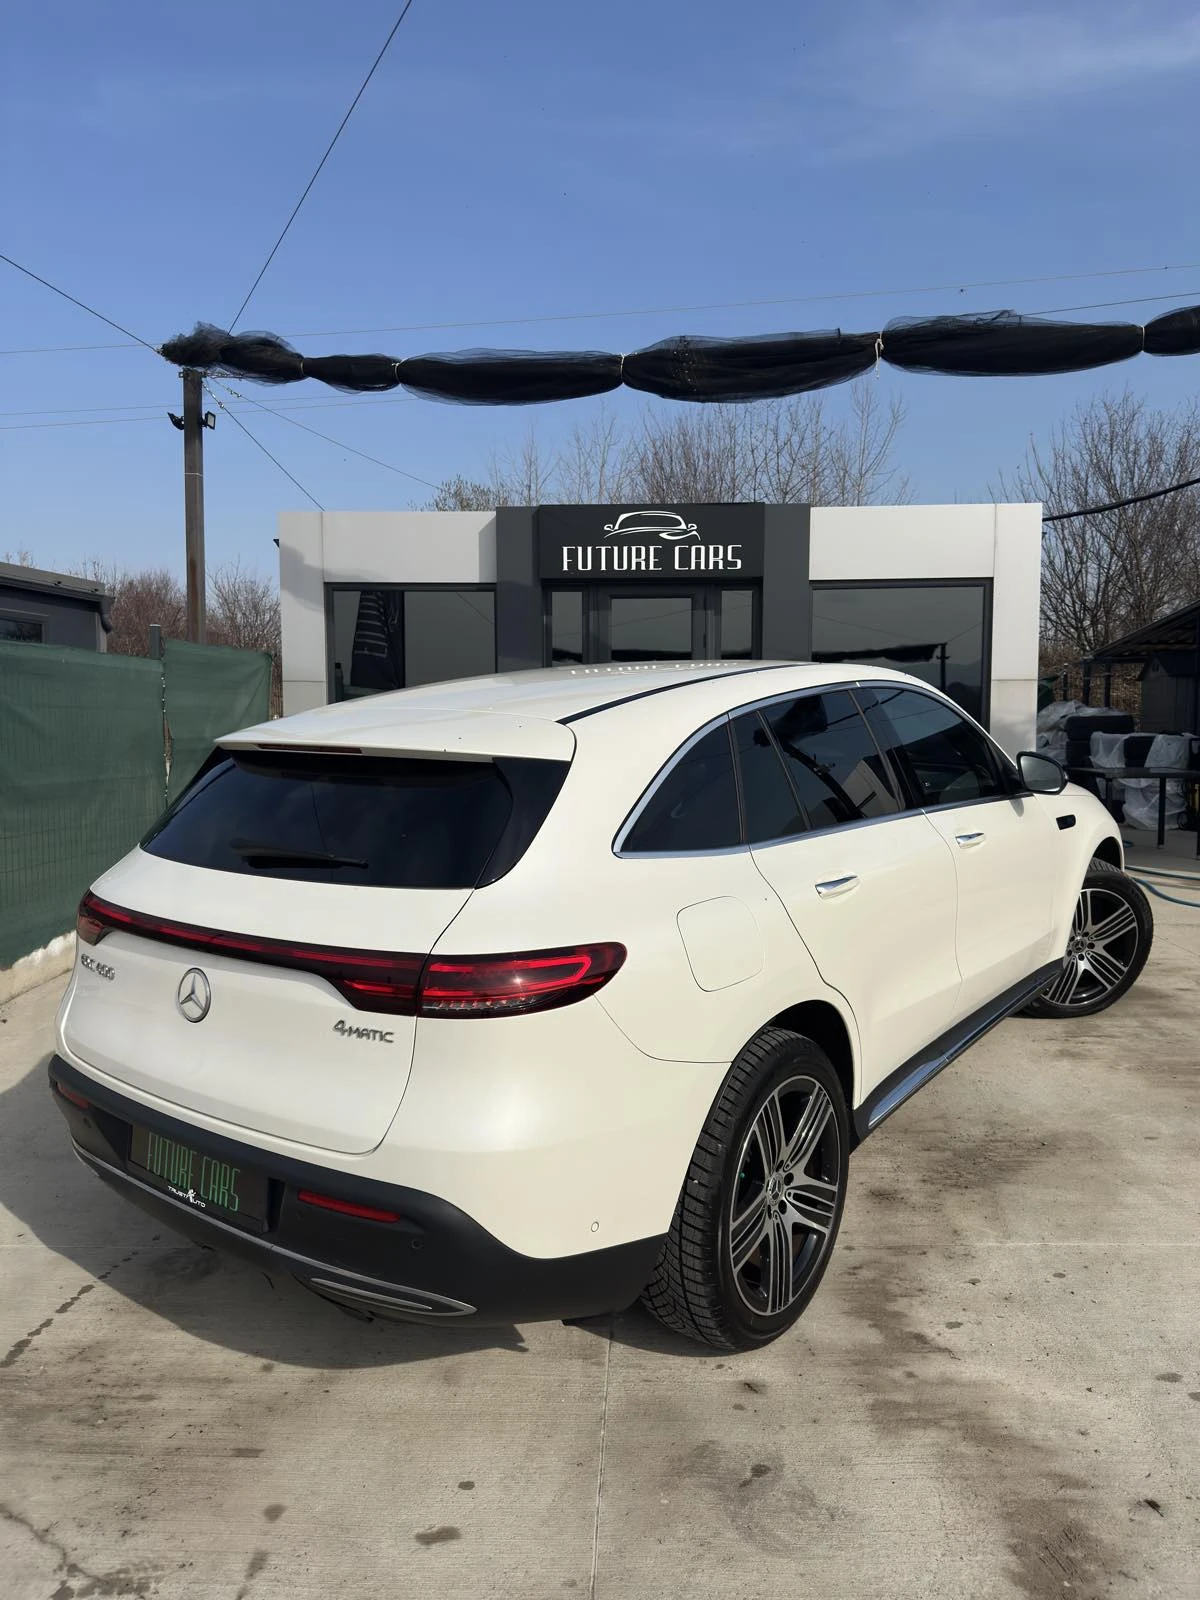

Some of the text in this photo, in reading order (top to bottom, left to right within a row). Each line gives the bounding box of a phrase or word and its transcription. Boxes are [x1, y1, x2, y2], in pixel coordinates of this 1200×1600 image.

[562, 545, 742, 571] FUTURE CARS
[147, 1132, 240, 1212] FUTURE CARS
